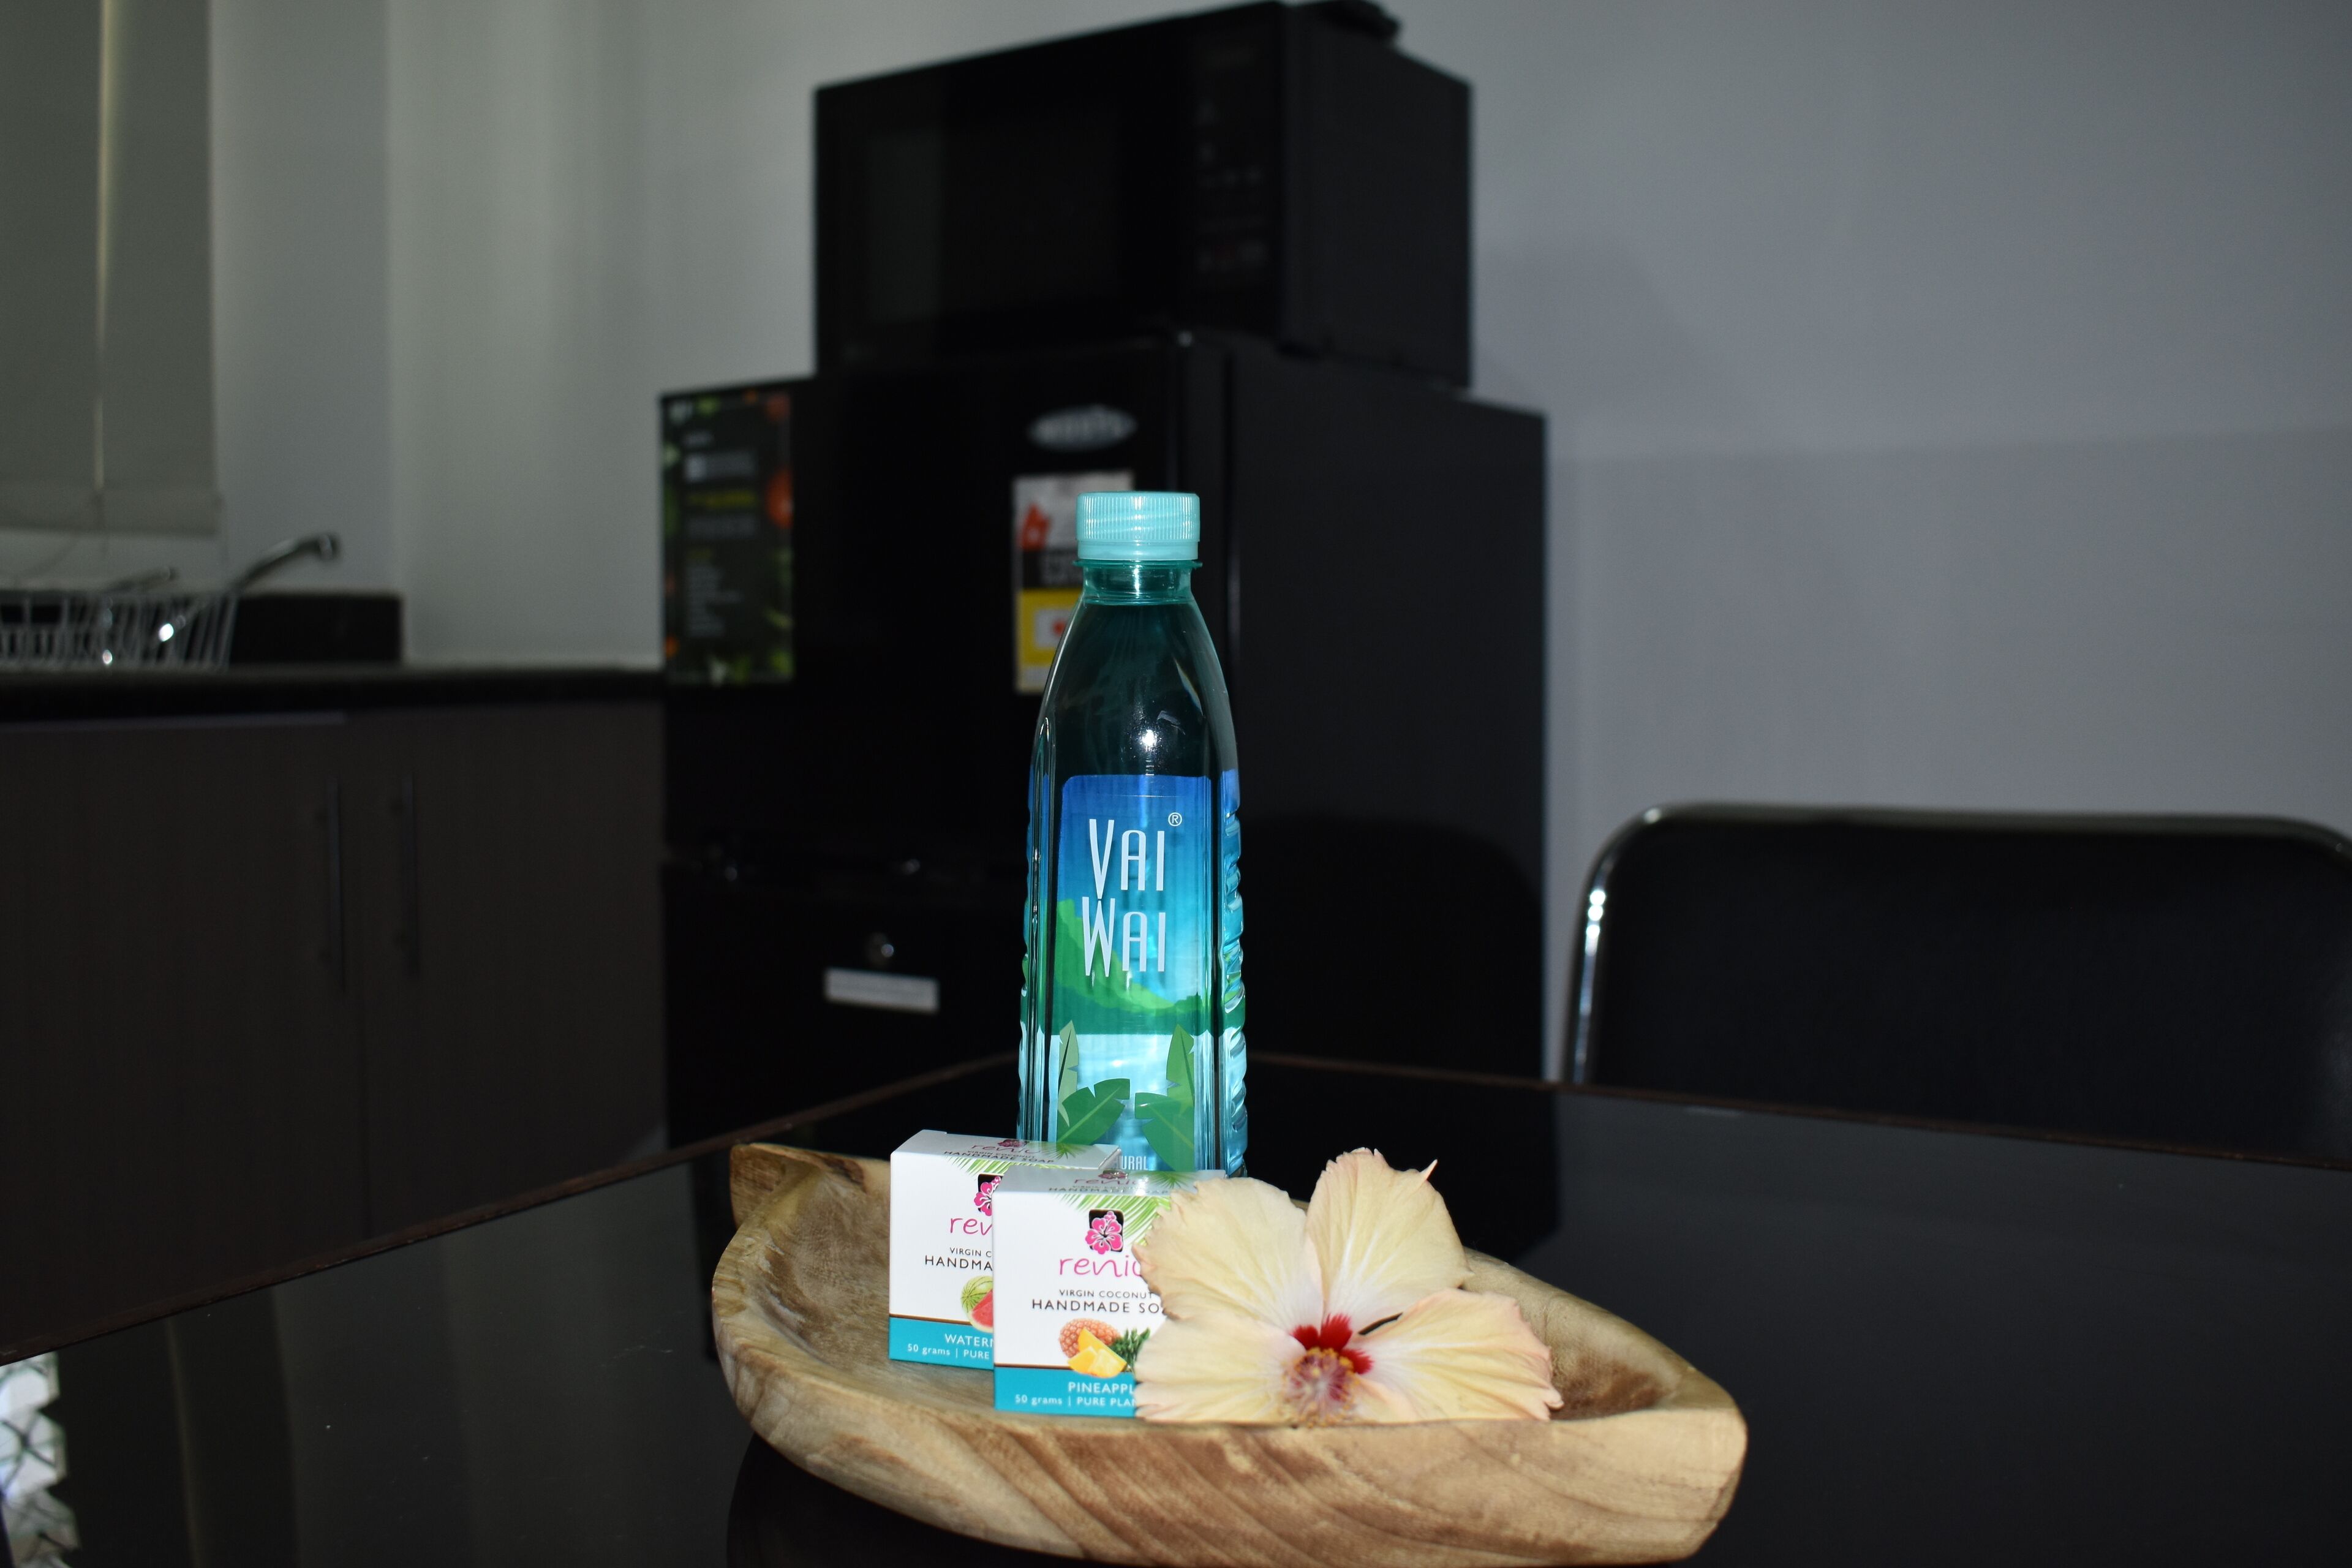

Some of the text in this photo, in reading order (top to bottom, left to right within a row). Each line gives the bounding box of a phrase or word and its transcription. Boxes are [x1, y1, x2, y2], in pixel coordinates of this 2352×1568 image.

[1089, 818, 1165, 900] VAI
[1082, 896, 1166, 978] WAI
[944, 1151, 1016, 1161] HANDMADE
[1121, 1155, 1148, 1171] URAL
[950, 1247, 982, 1257] VIRGIN
[925, 1254, 993, 1271] HANDMA
[1099, 1291, 1153, 1299] COCONUT
[1032, 1298, 1161, 1314] HANDMADE SO
[944, 1333, 993, 1348] WATER
[908, 1343, 990, 1359] 50 grams PURE
[1068, 1382, 1134, 1394] PINEAPPL
[1015, 1394, 1028, 1403] 50
[1031, 1396, 1063, 1406] grams
[1077, 1396, 1106, 1406] PURE
